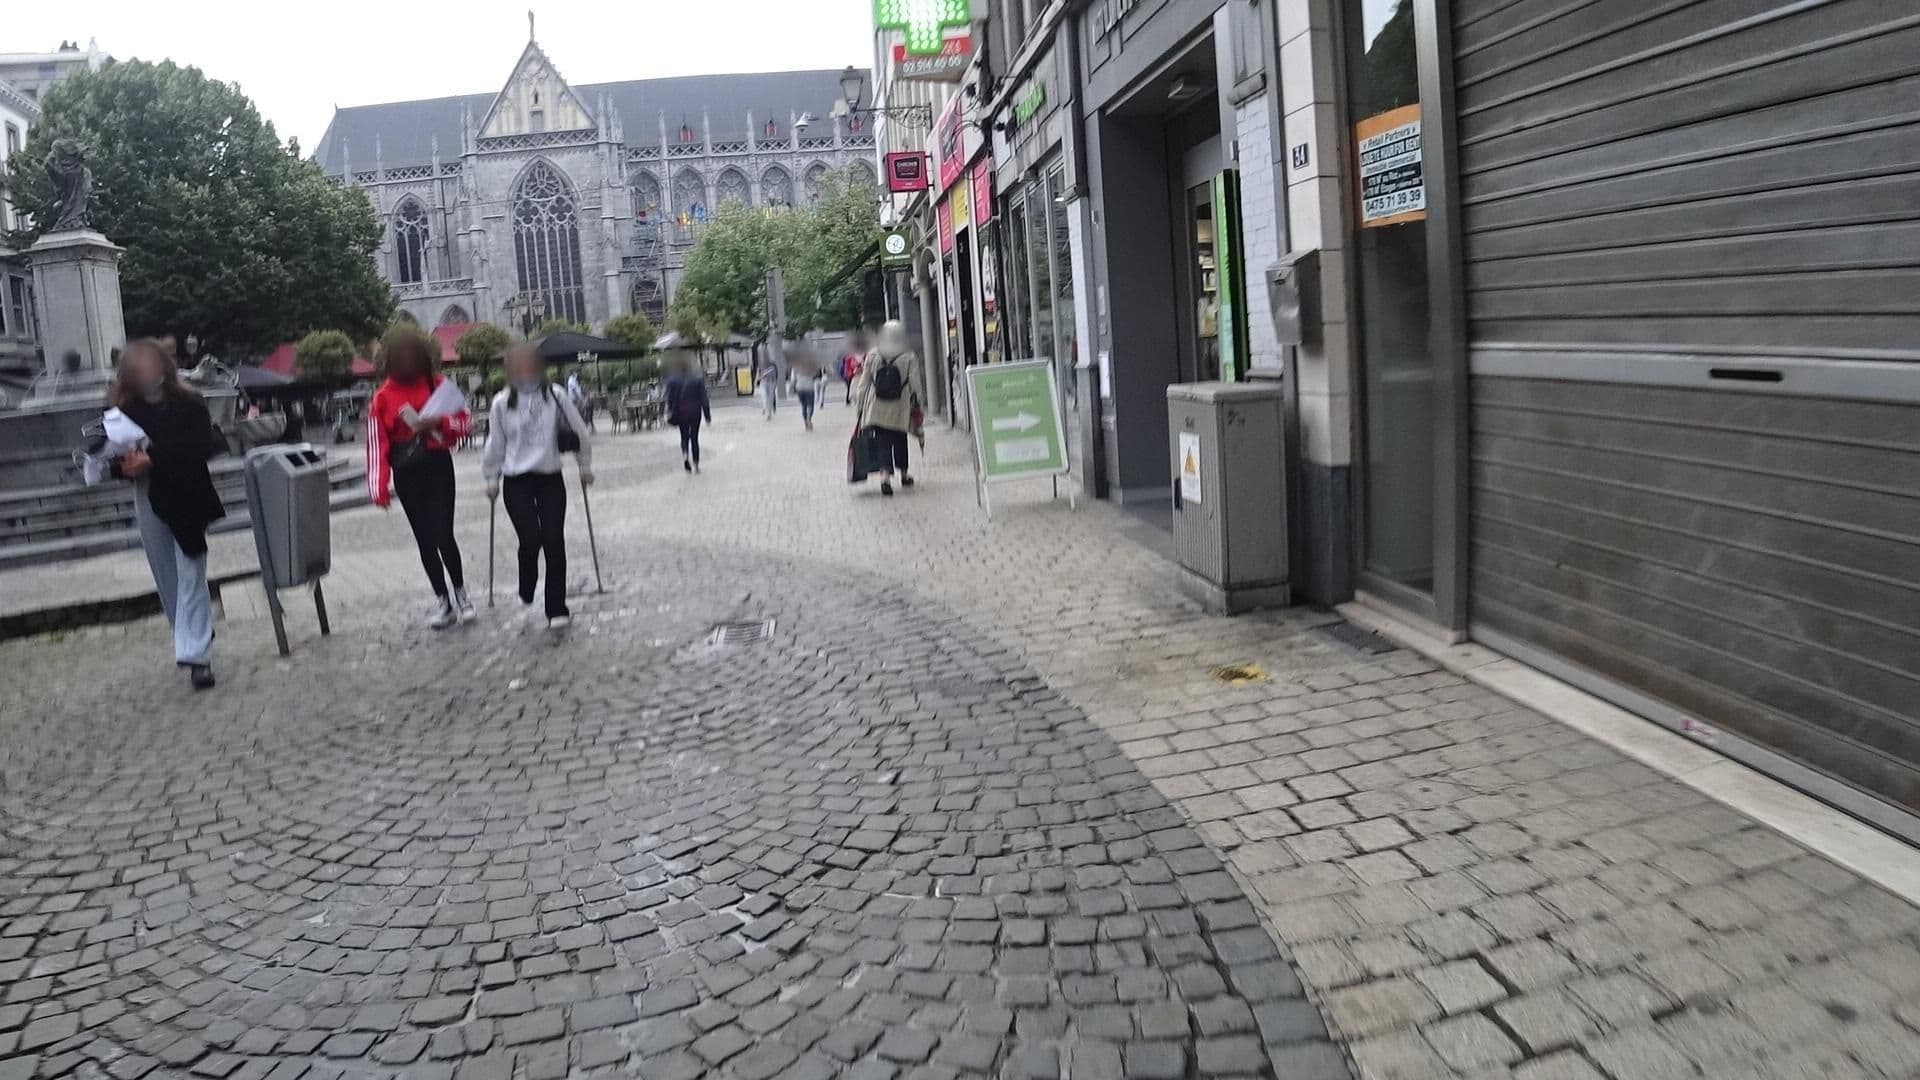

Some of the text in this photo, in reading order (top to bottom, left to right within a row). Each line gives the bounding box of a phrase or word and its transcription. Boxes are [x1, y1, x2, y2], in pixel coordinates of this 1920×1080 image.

[1366, 197, 1385, 213] 0475
[1386, 194, 1395, 208] 71
[1397, 191, 1407, 206] 39
[1409, 188, 1421, 202] 39
